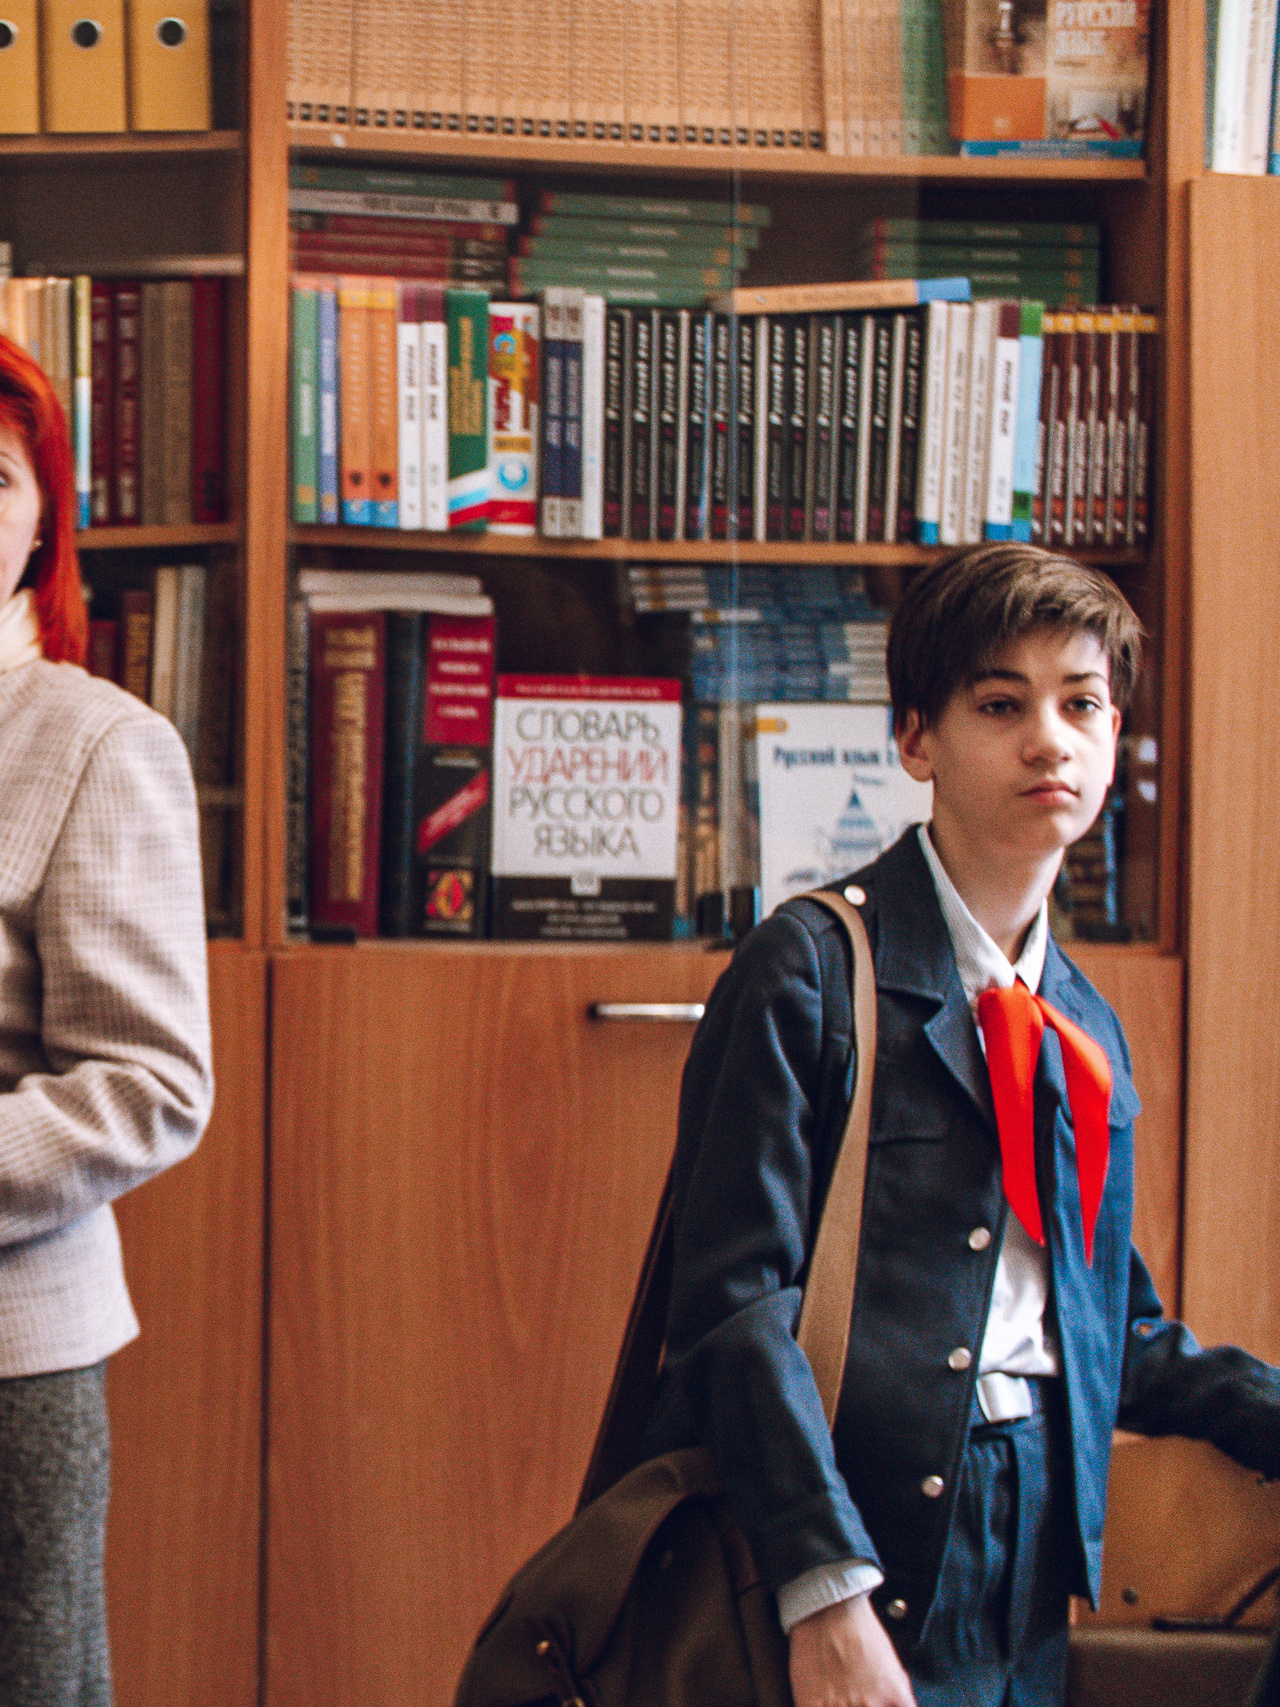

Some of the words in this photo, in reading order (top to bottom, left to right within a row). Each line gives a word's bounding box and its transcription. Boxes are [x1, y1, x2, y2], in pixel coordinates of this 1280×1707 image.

[516, 706, 660, 744] СЛОВАРЬ
[774, 747, 834, 769] Русский
[508, 785, 665, 822] РУССКОГО
[534, 821, 642, 858] ЯЗЫКА
